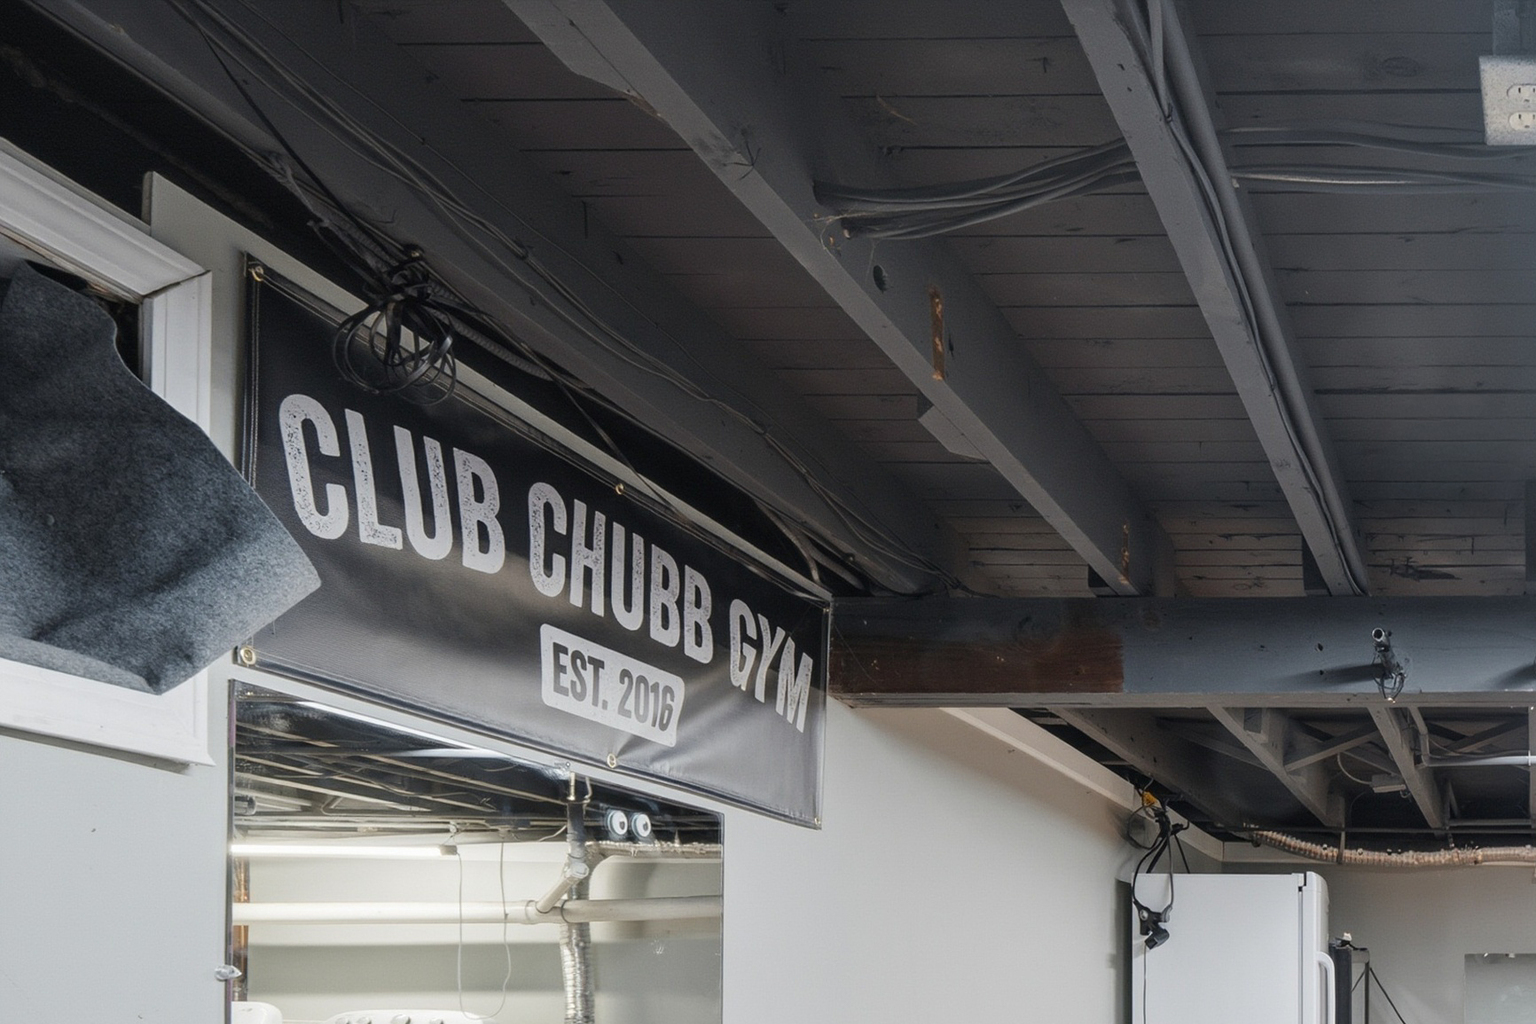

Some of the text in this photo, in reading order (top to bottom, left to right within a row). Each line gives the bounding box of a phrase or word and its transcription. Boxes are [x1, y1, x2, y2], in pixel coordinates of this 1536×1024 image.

[279, 393, 814, 734] CLUB CHUBB GYM
[551, 642, 676, 732] EST. 2016
